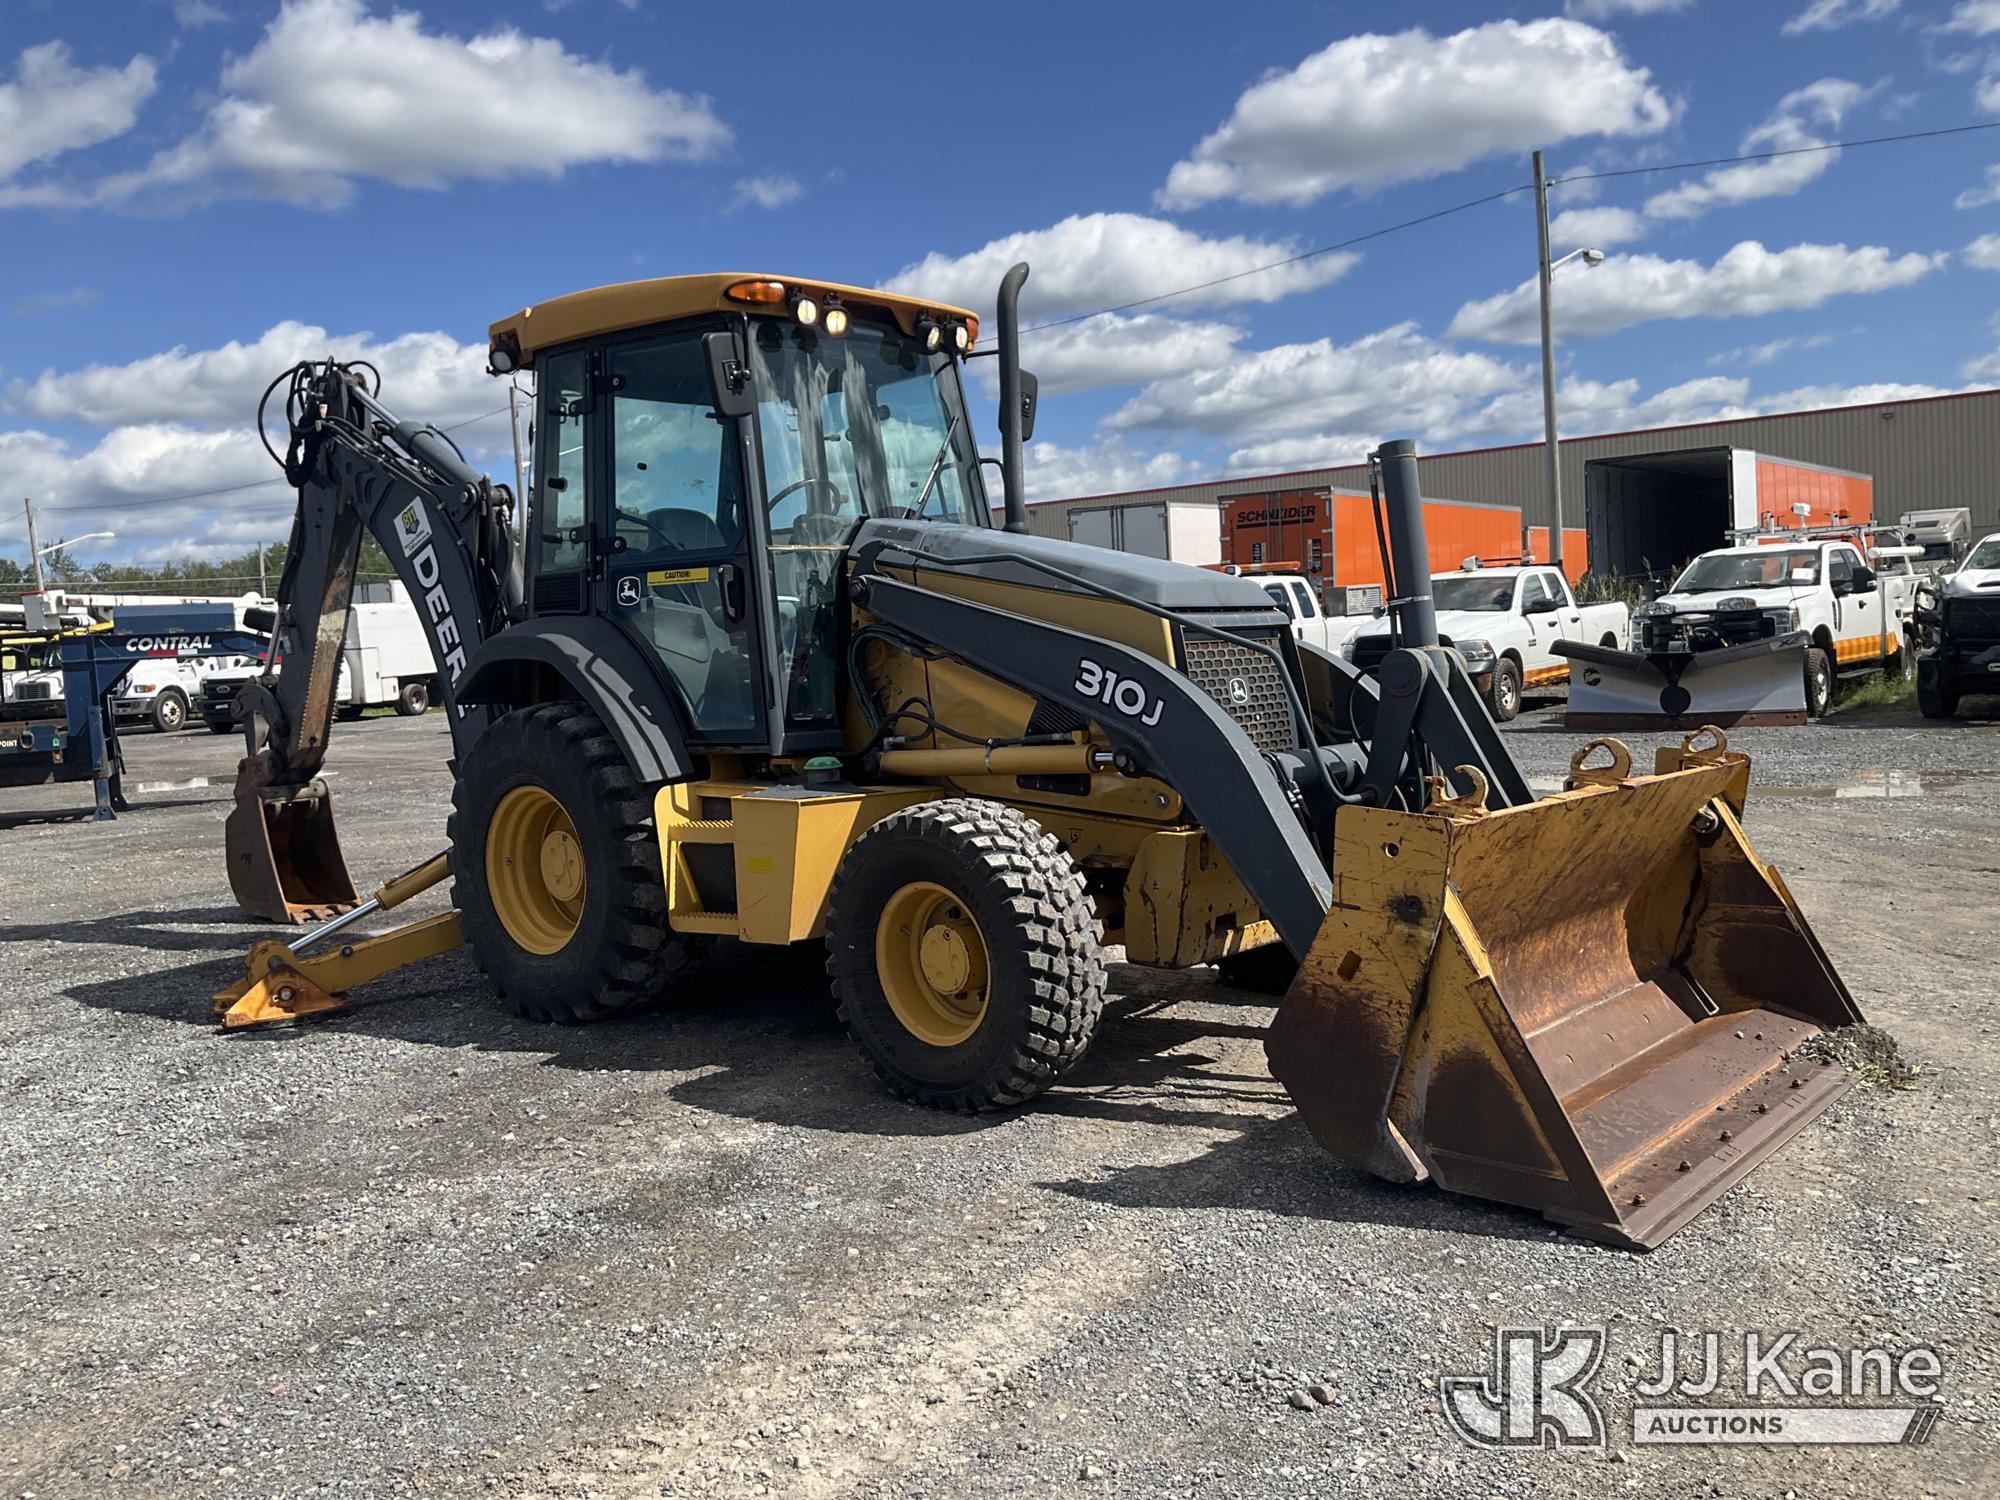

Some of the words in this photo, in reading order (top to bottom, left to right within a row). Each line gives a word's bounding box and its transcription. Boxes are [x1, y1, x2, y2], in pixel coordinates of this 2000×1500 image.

[1237, 505, 1316, 522] SCHNEIDER
[412, 543, 477, 718] DEER
[126, 635, 212, 652] CONTRAL
[1074, 659, 1164, 726] 310J
[0, 739, 17, 747] OINT
